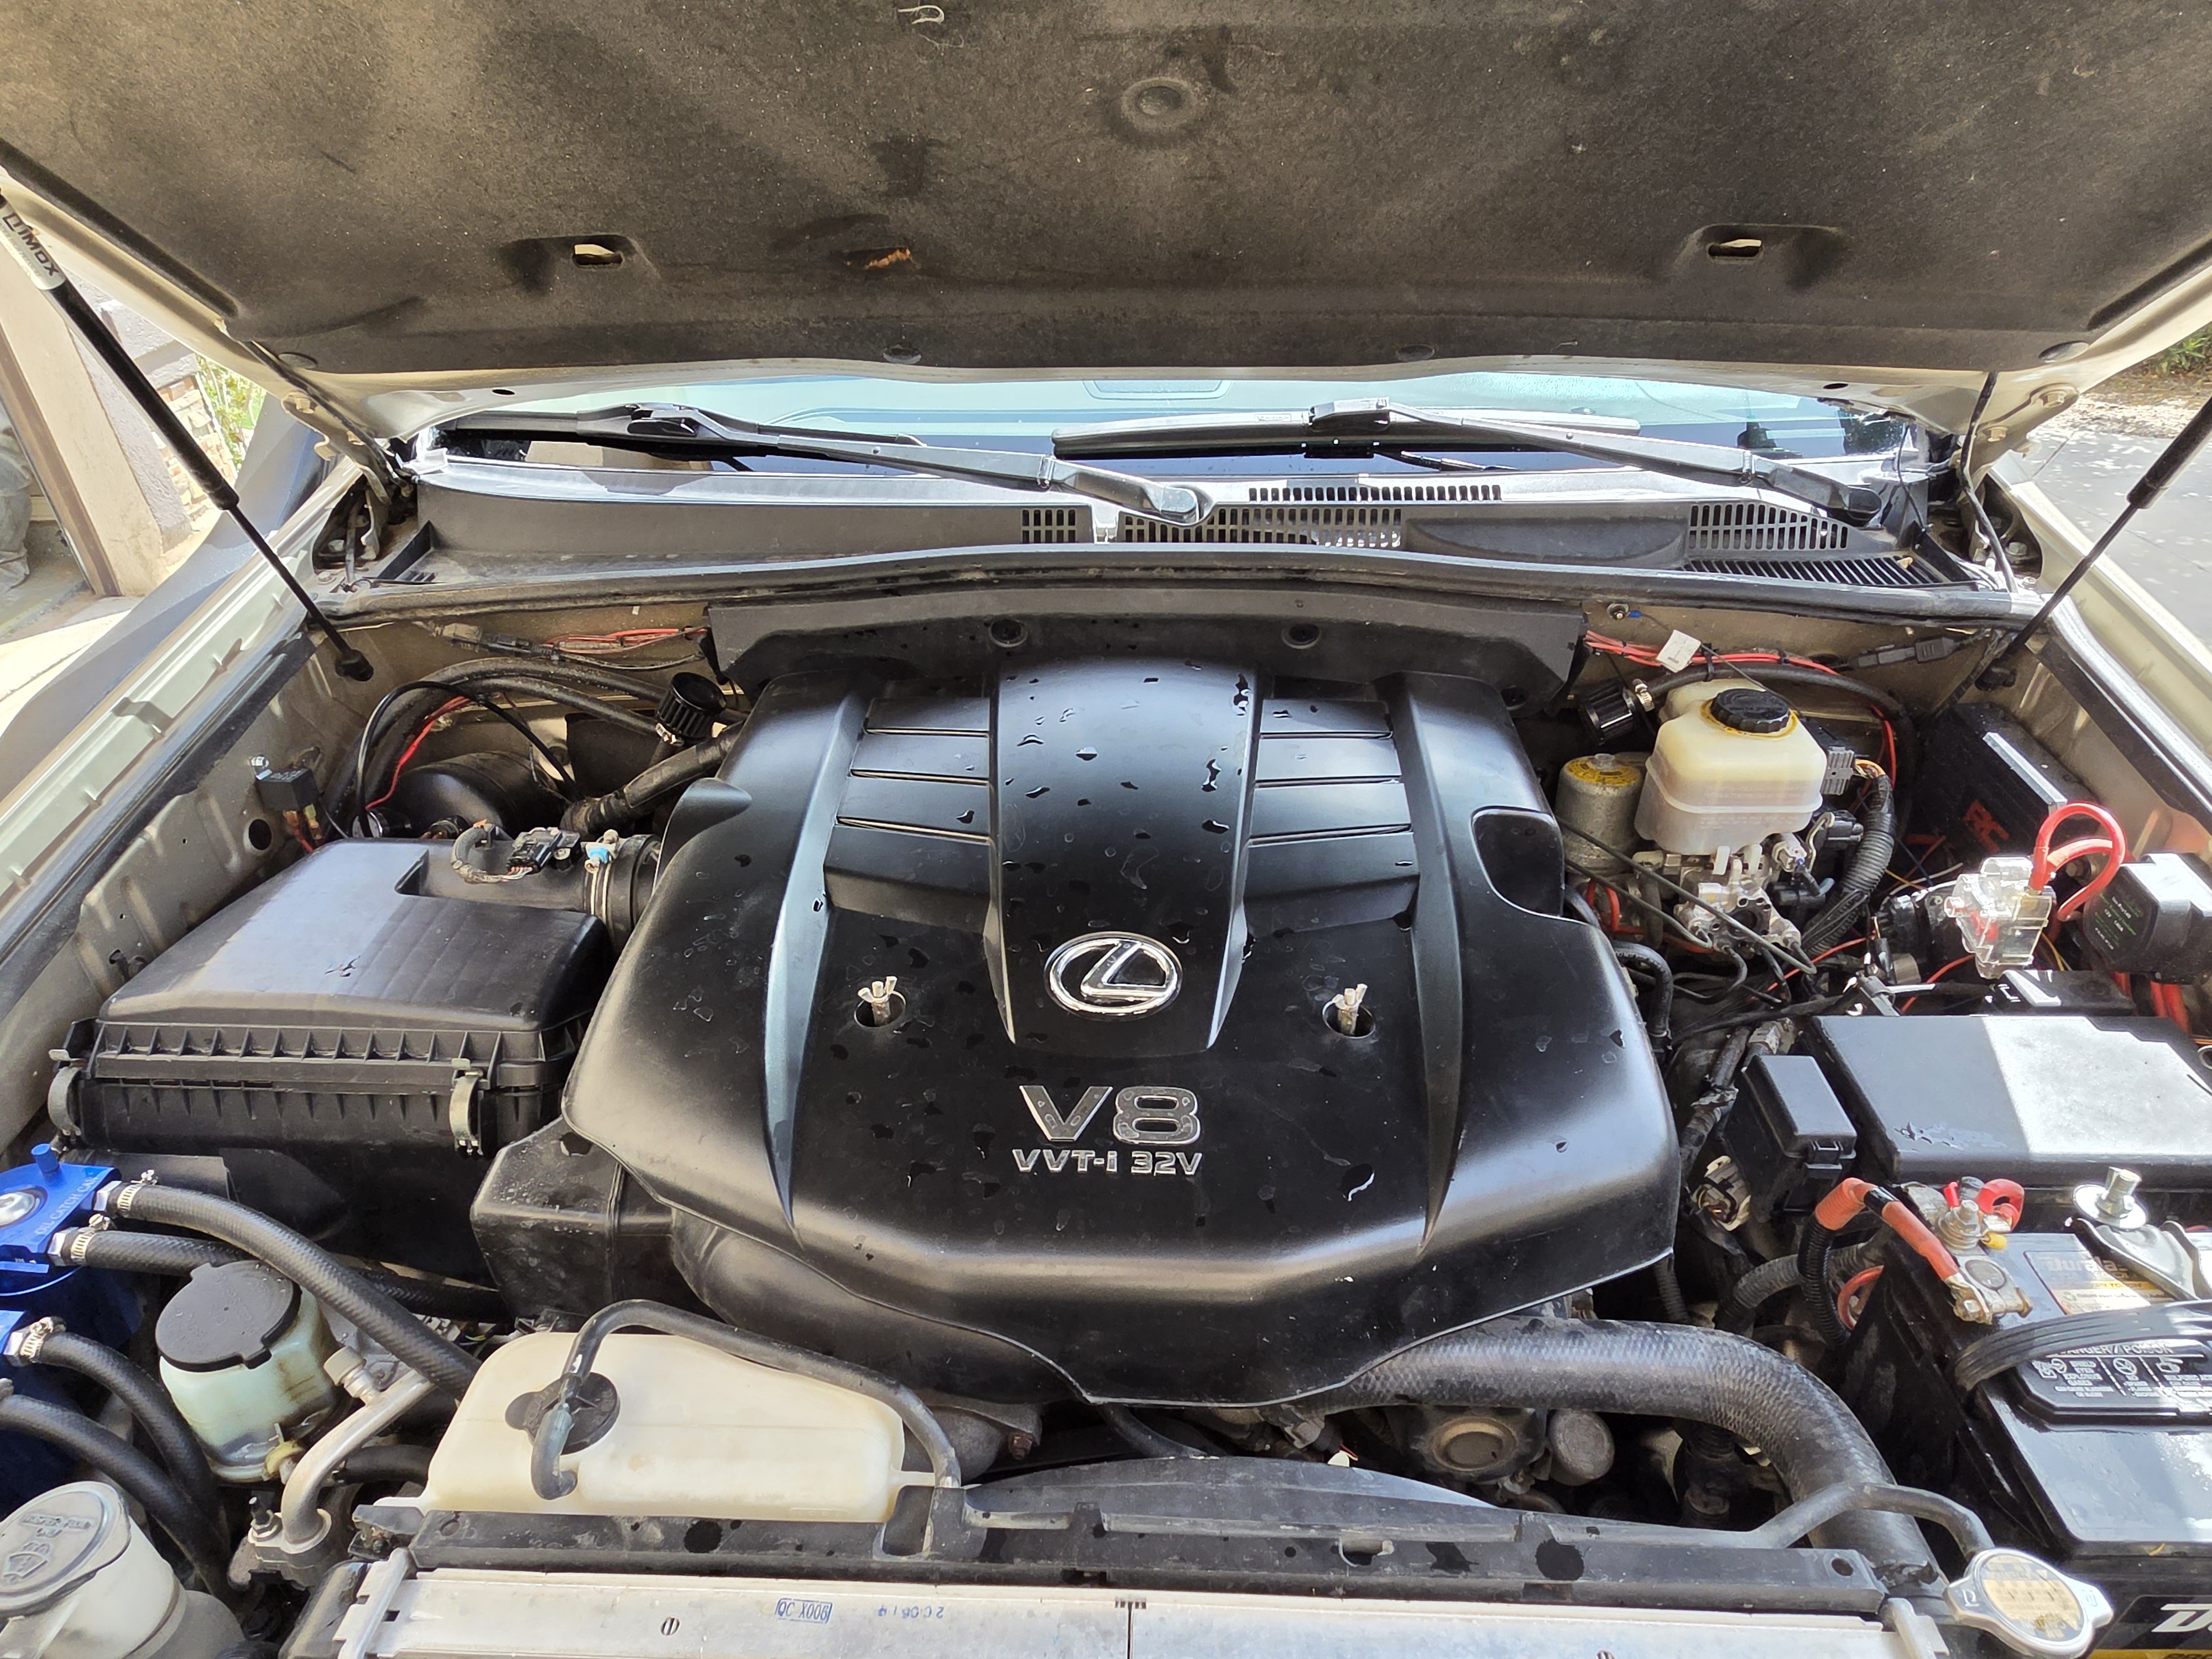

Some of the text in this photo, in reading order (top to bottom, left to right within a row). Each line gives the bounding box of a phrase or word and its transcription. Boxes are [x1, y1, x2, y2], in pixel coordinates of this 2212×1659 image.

[1019, 1086, 1201, 1145] V8
[1013, 1149, 1202, 1176] VVT-i 32V
[34, 1220, 55, 1235] OIL
[50, 1192, 80, 1220] CATCH
